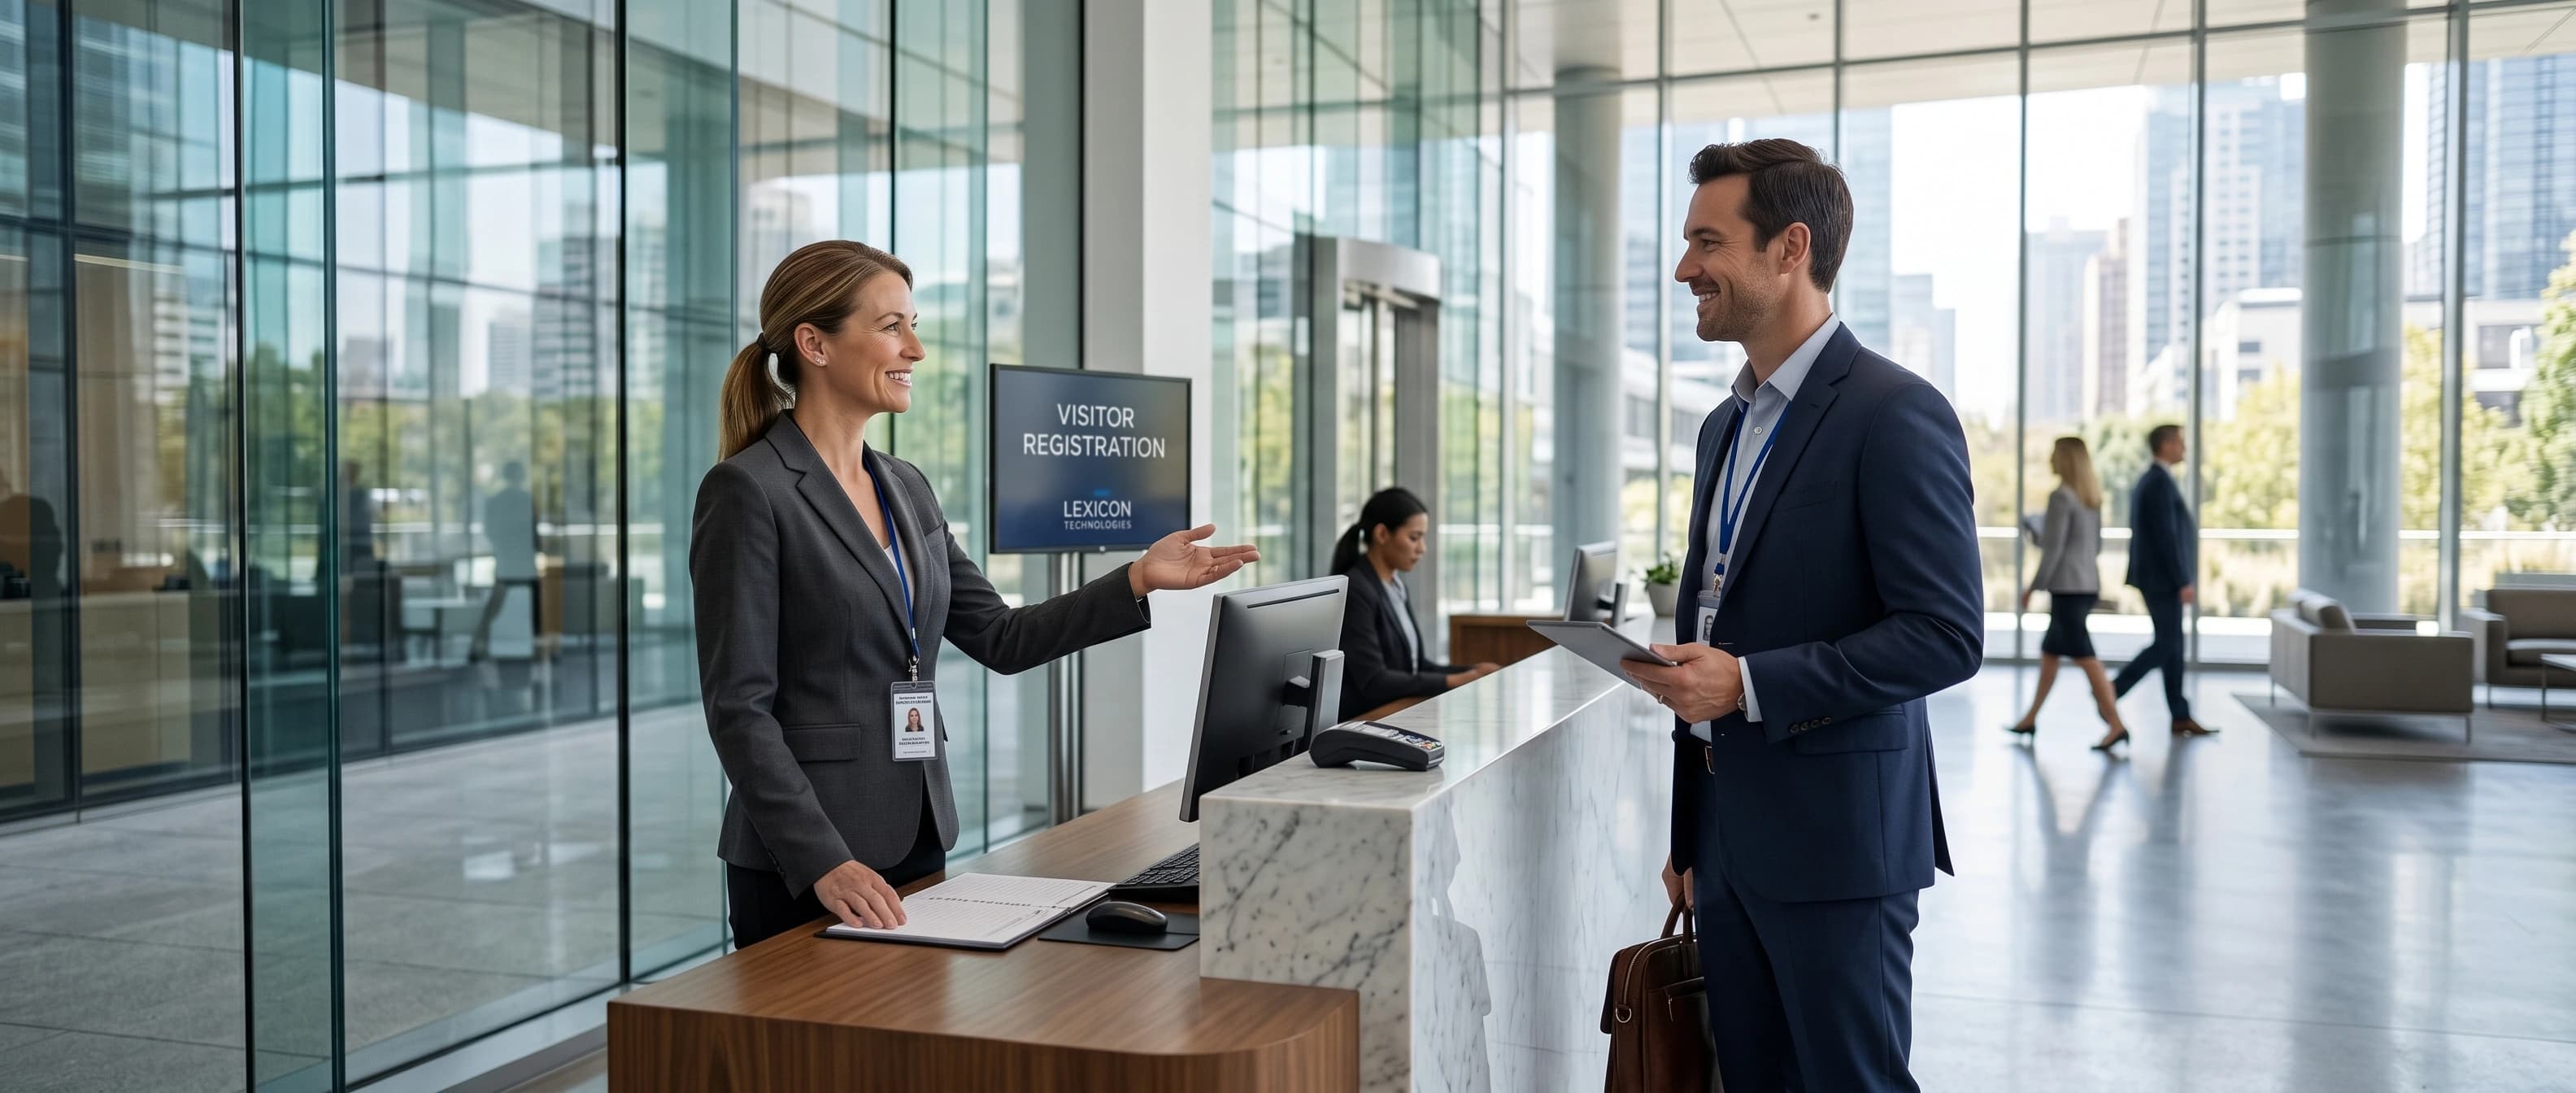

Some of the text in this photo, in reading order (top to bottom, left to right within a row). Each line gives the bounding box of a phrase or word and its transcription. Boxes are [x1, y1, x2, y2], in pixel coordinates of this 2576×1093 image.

[1057, 404, 1134, 428] VISITOR
[1023, 433, 1165, 458] REGISTRATION
[1064, 501, 1132, 518] LEXICON
[1064, 520, 1132, 529] TECHNOLOGIES
